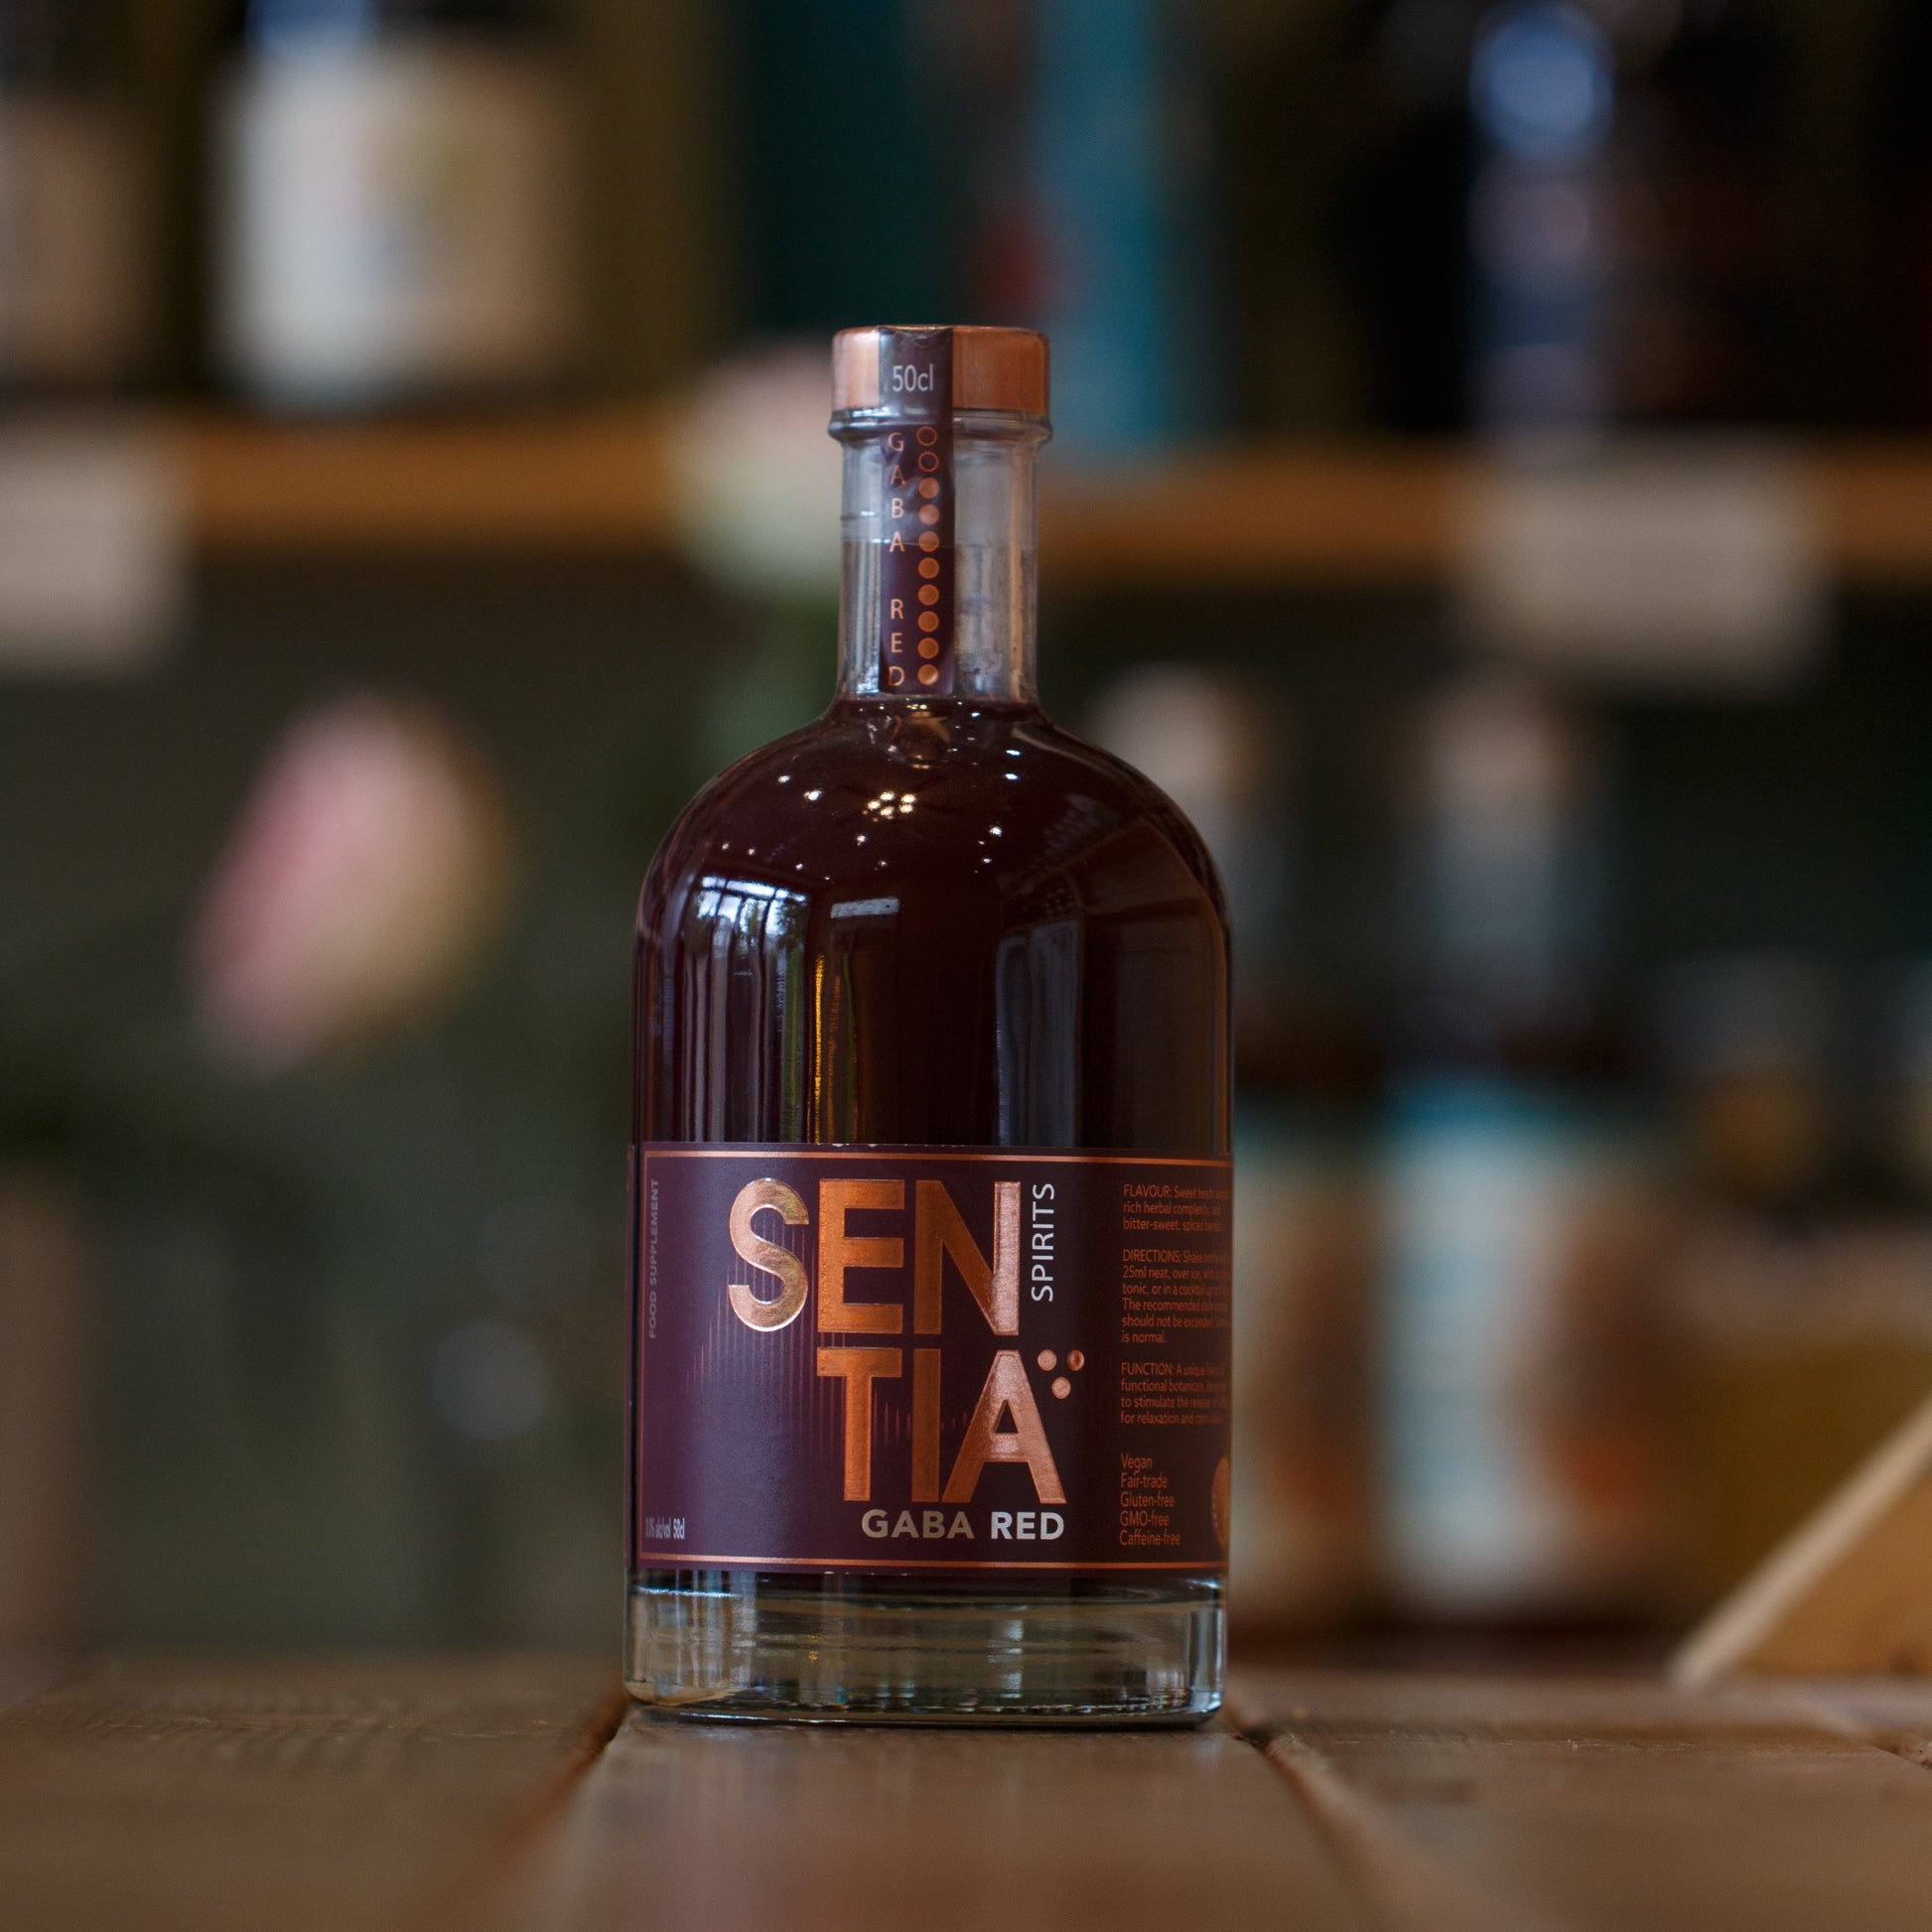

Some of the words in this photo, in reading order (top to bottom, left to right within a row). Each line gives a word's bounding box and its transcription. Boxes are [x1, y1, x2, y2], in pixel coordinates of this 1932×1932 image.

[892, 363, 934, 392] 50cl
[1123, 1184, 1173, 1198] FLAVOUR:
[1173, 1185, 1196, 1199] Sweet
[1123, 1201, 1142, 1214] rich
[1144, 1201, 1172, 1214] herbal
[649, 1178, 659, 1286] SUPPLEMENT
[1031, 1182, 1055, 1303] SPIRITS
[728, 1177, 1021, 1335] SEN
[1122, 1265, 1147, 1279] 25ml
[1149, 1267, 1171, 1281] neat,
[1173, 1269, 1189, 1279] over
[1122, 1283, 1150, 1297] tonic,
[1151, 1285, 1162, 1295] or
[1163, 1284, 1172, 1295] in
[1173, 1286, 1177, 1295] a
[1122, 1298, 1142, 1311] The
[648, 1291, 657, 1338] FOOD
[1122, 1313, 1154, 1327] should
[1156, 1315, 1171, 1327] not
[1173, 1315, 1182, 1327] be
[1122, 1330, 1130, 1342] is
[1175, 1363, 1182, 1375] A
[1121, 1379, 1168, 1392] functional
[1121, 1397, 1131, 1408] to
[1134, 1396, 1175, 1409] stimulate
[1176, 1397, 1188, 1408] the
[816, 1347, 1067, 1504] TIA
[1120, 1412, 1135, 1424] for
[1137, 1412, 1179, 1425] relaxation
[1121, 1453, 1153, 1474] Vegan
[1121, 1472, 1168, 1489] Fair-trade
[1120, 1490, 1175, 1508] Gluten-free
[861, 1509, 975, 1540] GABA
[990, 1511, 1064, 1540] RED
[1120, 1509, 1170, 1527] GMO-free
[1120, 1529, 1180, 1546] Caffeine-free
